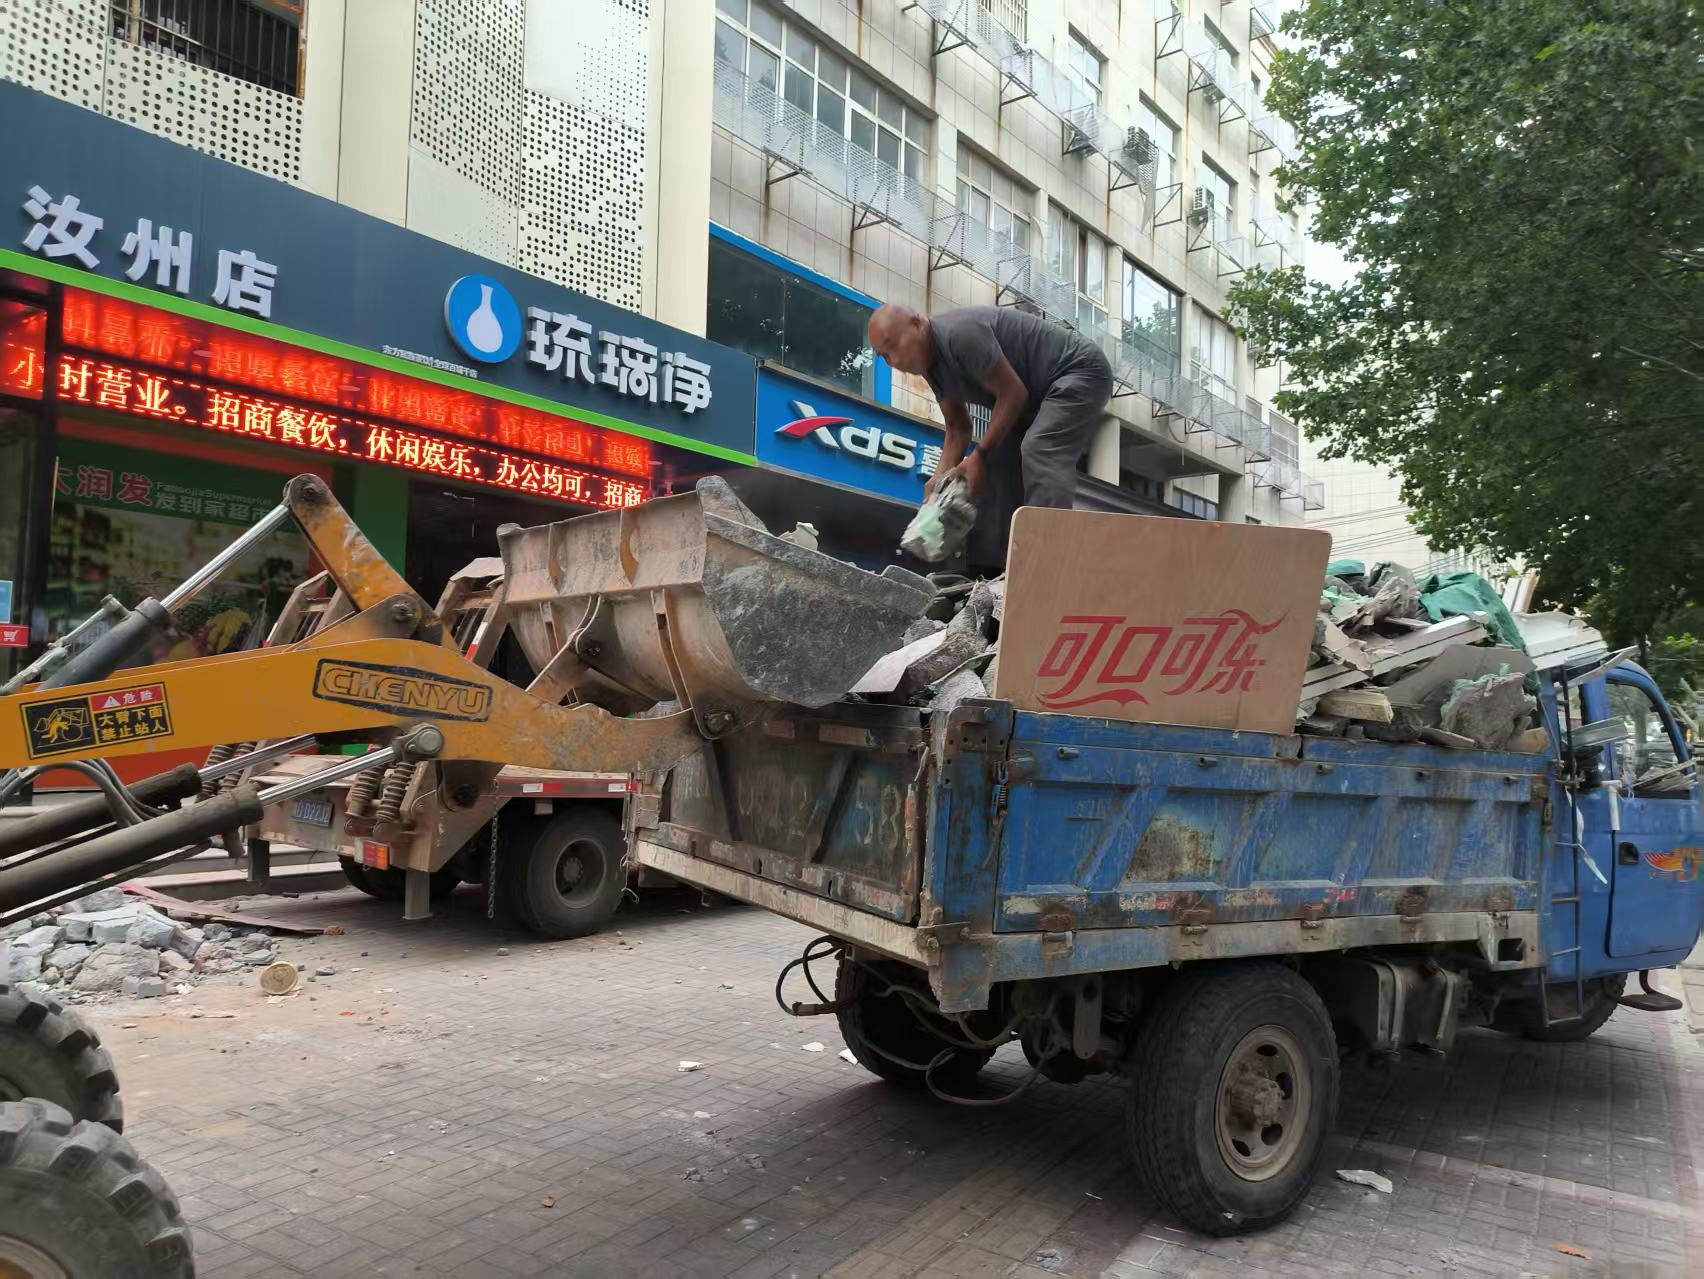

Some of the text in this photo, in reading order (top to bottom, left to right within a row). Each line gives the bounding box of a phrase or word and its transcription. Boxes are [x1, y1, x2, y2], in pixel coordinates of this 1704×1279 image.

[22, 184, 278, 319] 汝州店
[528, 305, 713, 414] 琉璃净
[1036, 608, 1289, 698] 可口可乐
[123, 689, 153, 705] 危险
[323, 666, 487, 714] CHENYU
[98, 704, 163, 727] 大臂下面
[102, 719, 166, 741] 禁止站人
